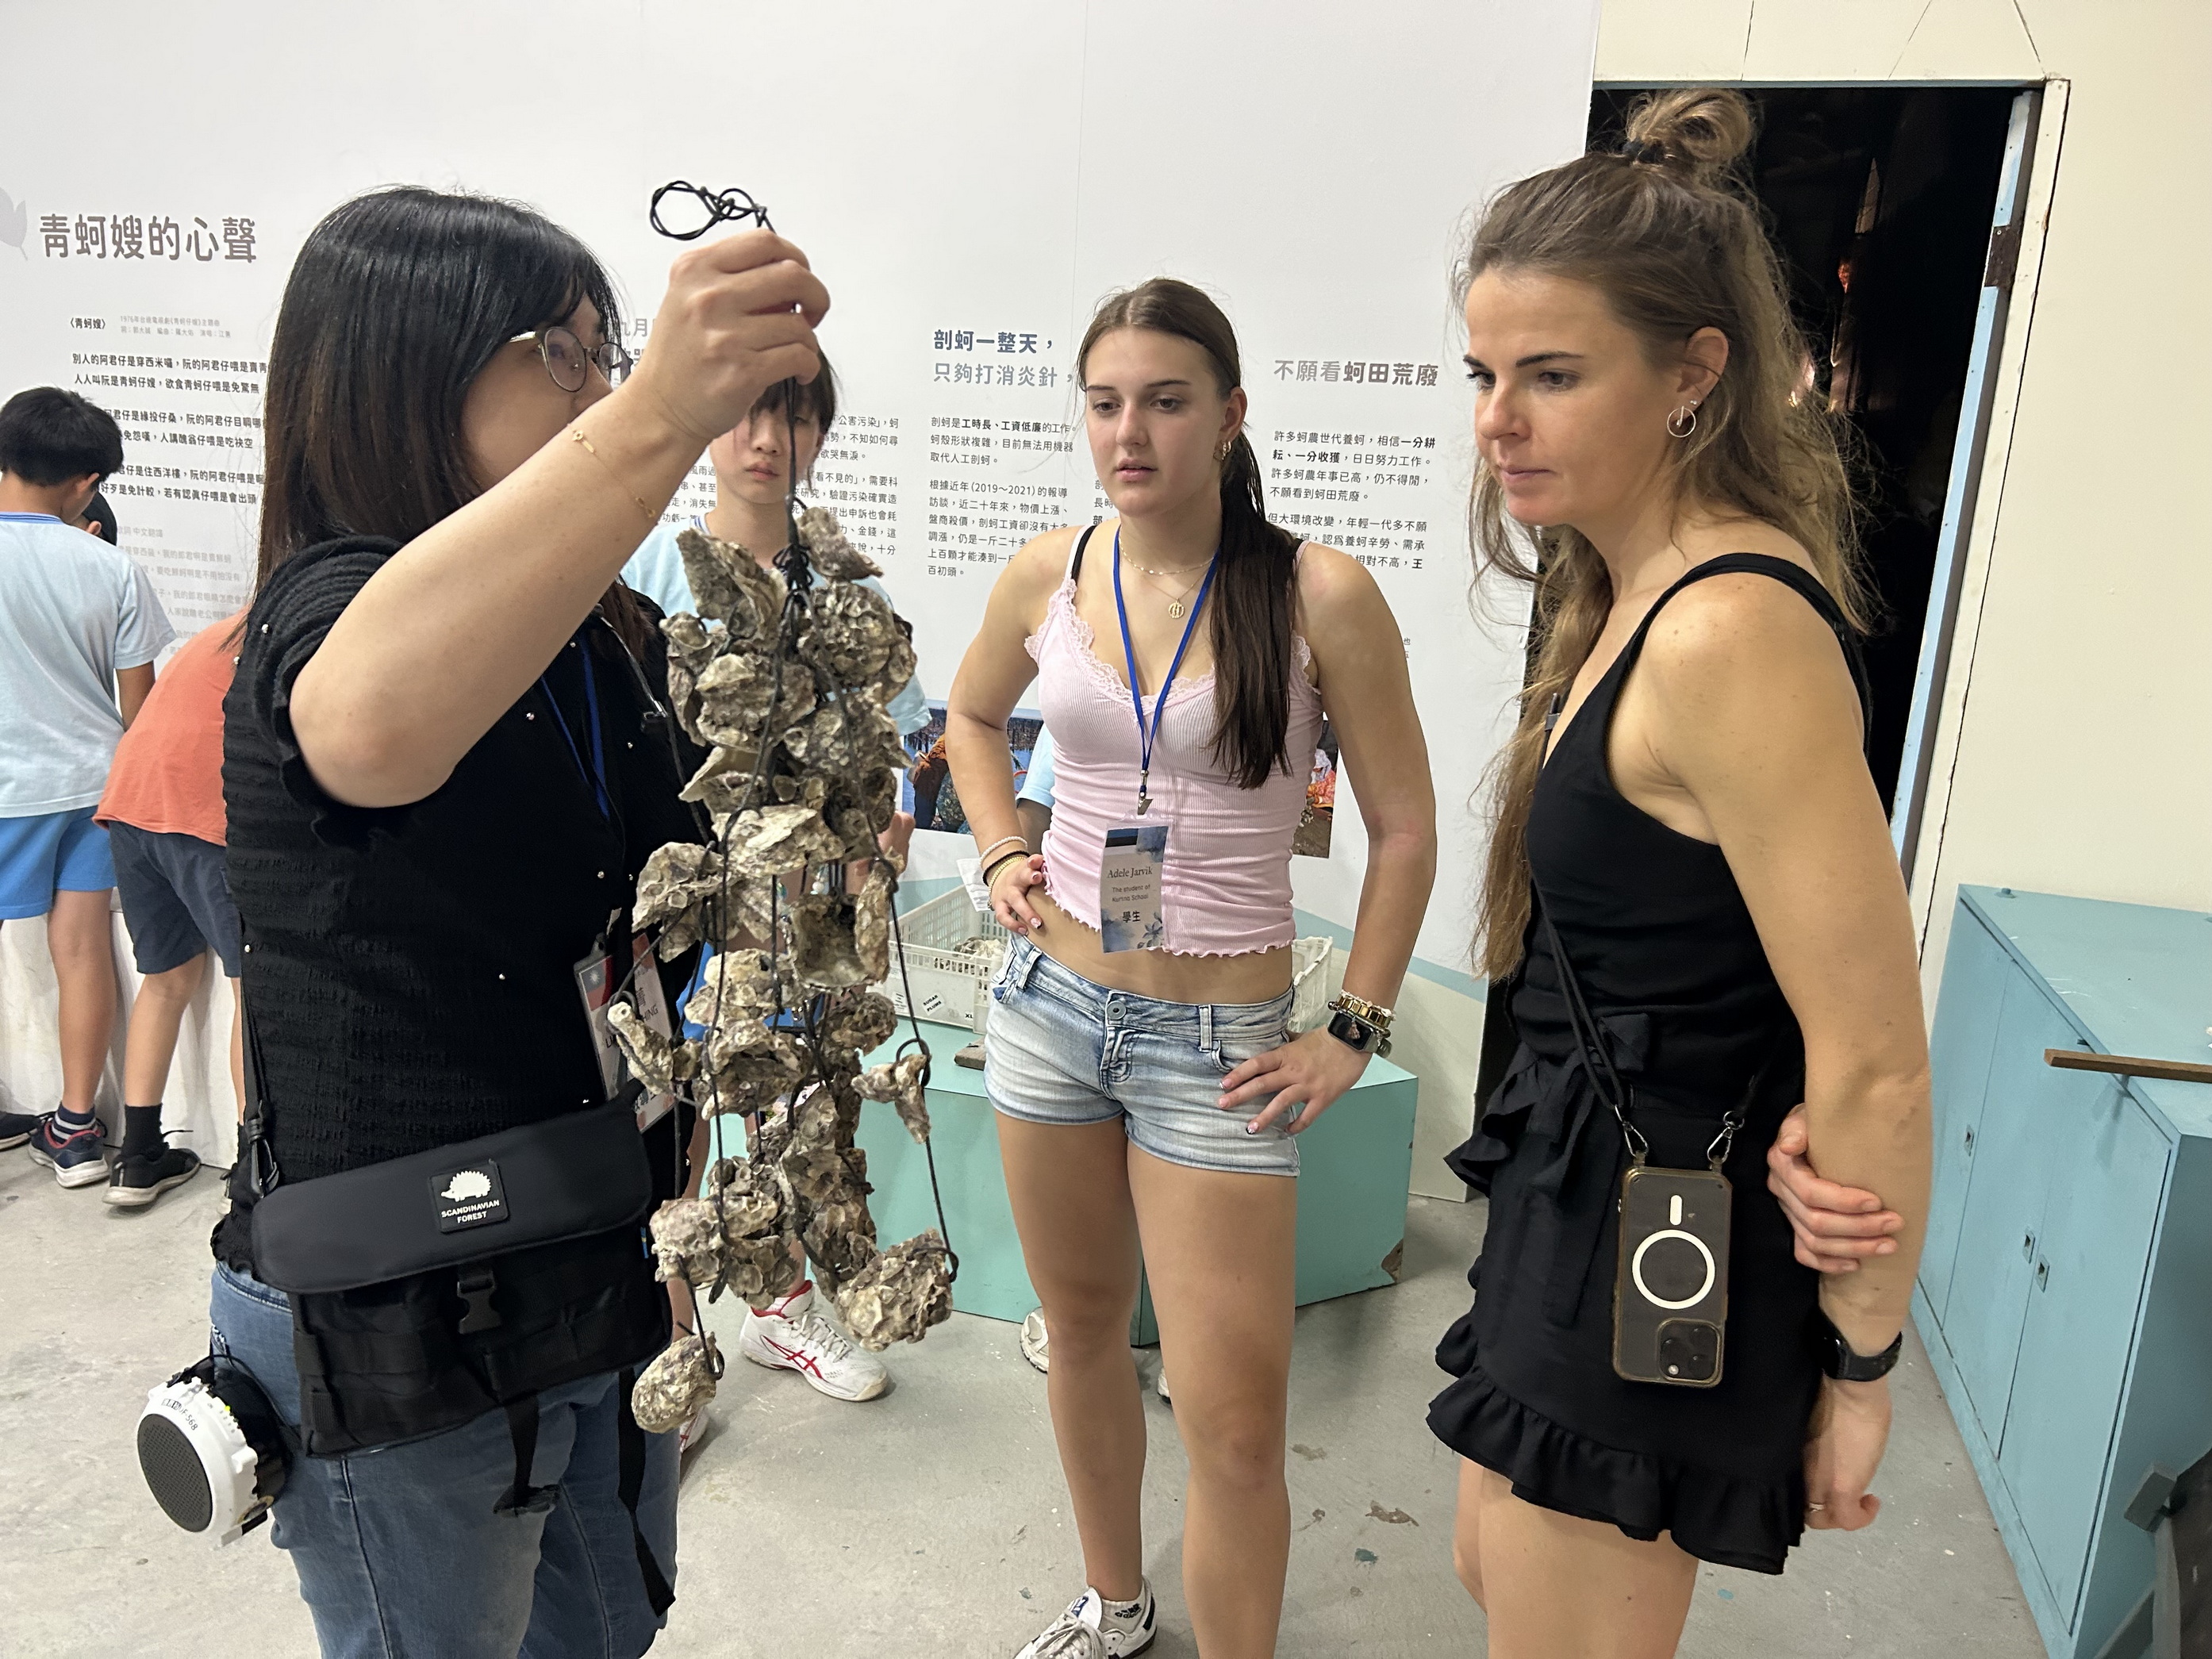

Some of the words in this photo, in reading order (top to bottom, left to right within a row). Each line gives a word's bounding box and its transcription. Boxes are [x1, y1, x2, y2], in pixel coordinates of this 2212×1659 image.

[40, 213, 256, 263] 青蚵嫂的心聲
[934, 329, 1054, 354] 剖蚵一整天,
[934, 363, 1073, 388] 只夠打消炎針,
[1273, 359, 1438, 387] 不願看蚵田荒廢
[931, 434, 1073, 452] 蚵殼形狀複雜,目前無法用機器
[1273, 430, 1436, 449] 許多蚵農世代養蚵,相信一分耕
[817, 449, 867, 461] 欲哭無淚。
[930, 451, 999, 466] 取代人工剖蚵。
[1269, 486, 1369, 502] 不願看到蚵田荒廢。
[667, 497, 716, 509] 走,消失無
[929, 496, 1069, 516] 訪談,近二十年來,物價上漲、
[1268, 513, 1427, 532] 但大環境改變,年輕一代多不願
[928, 531, 1034, 548] 調漲,仍是一斤二十多
[927, 565, 965, 578] 百初頭。
[1107, 868, 1130, 878] Adele
[1130, 866, 1153, 878] Jarvik
[1123, 910, 1141, 923] 學生
[441, 1199, 500, 1218] SCANDINAVIAN
[457, 1211, 488, 1223] FOREST
